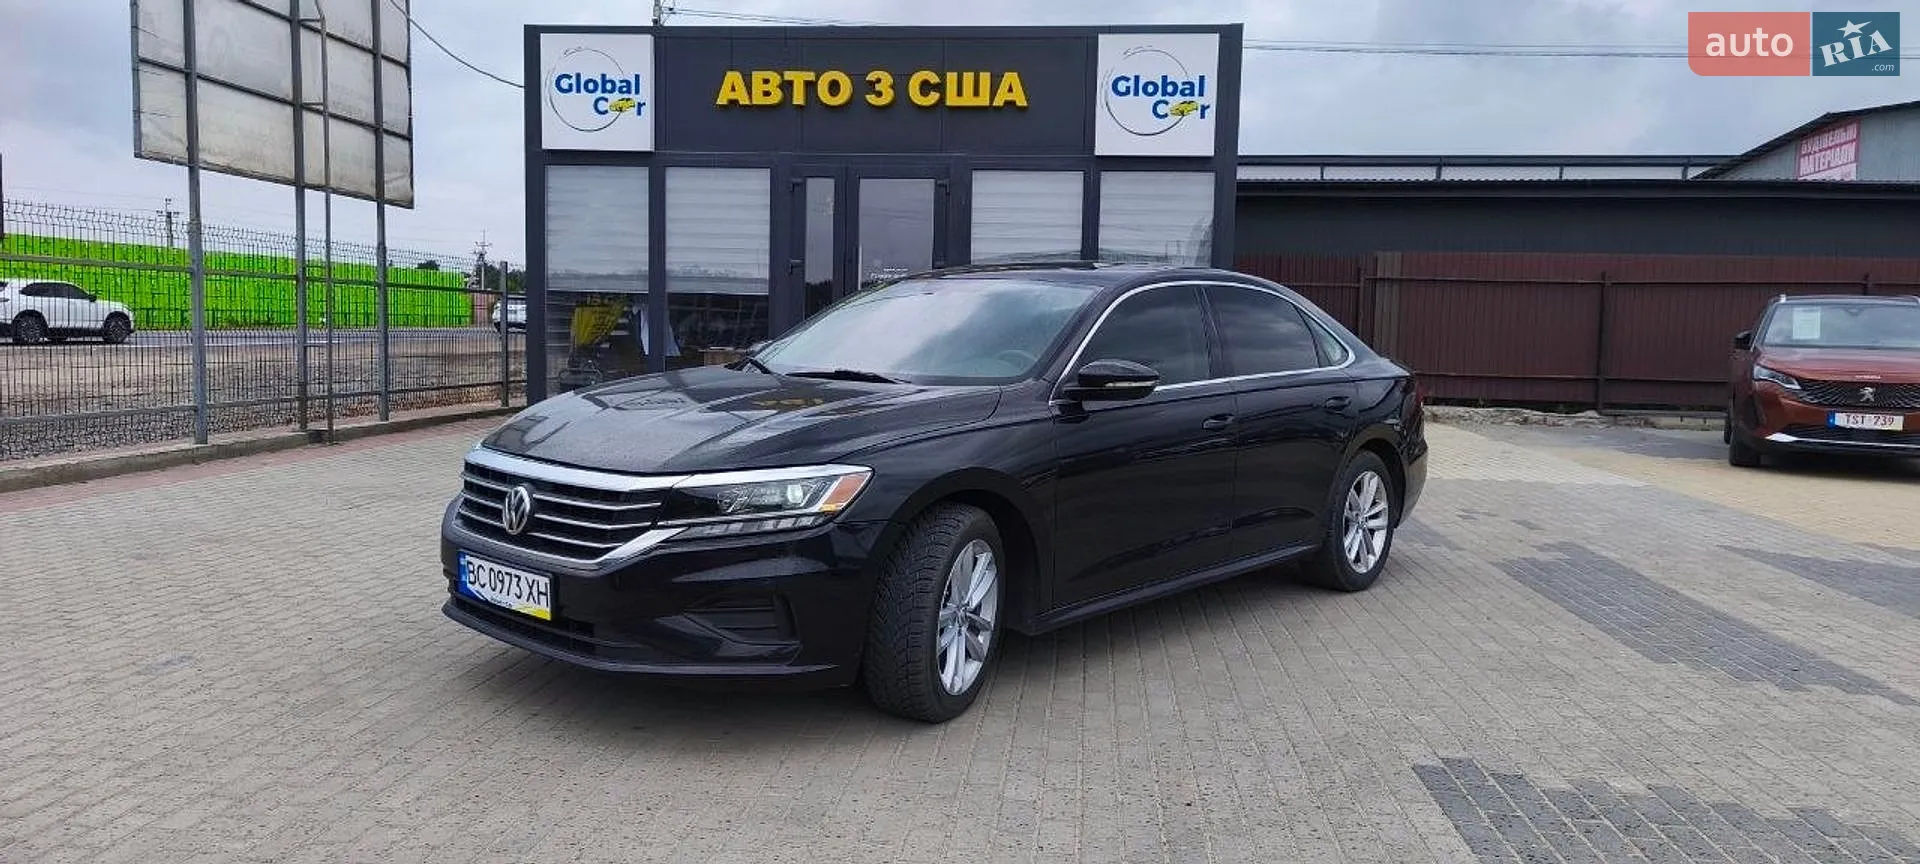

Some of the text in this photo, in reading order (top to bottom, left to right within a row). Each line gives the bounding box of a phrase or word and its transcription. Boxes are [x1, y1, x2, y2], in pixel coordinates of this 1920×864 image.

[554, 72, 640, 95] Global
[716, 70, 854, 107] АВТО
[908, 70, 1029, 107] США
[1111, 74, 1206, 97] Global
[488, 567, 523, 600] 0973
